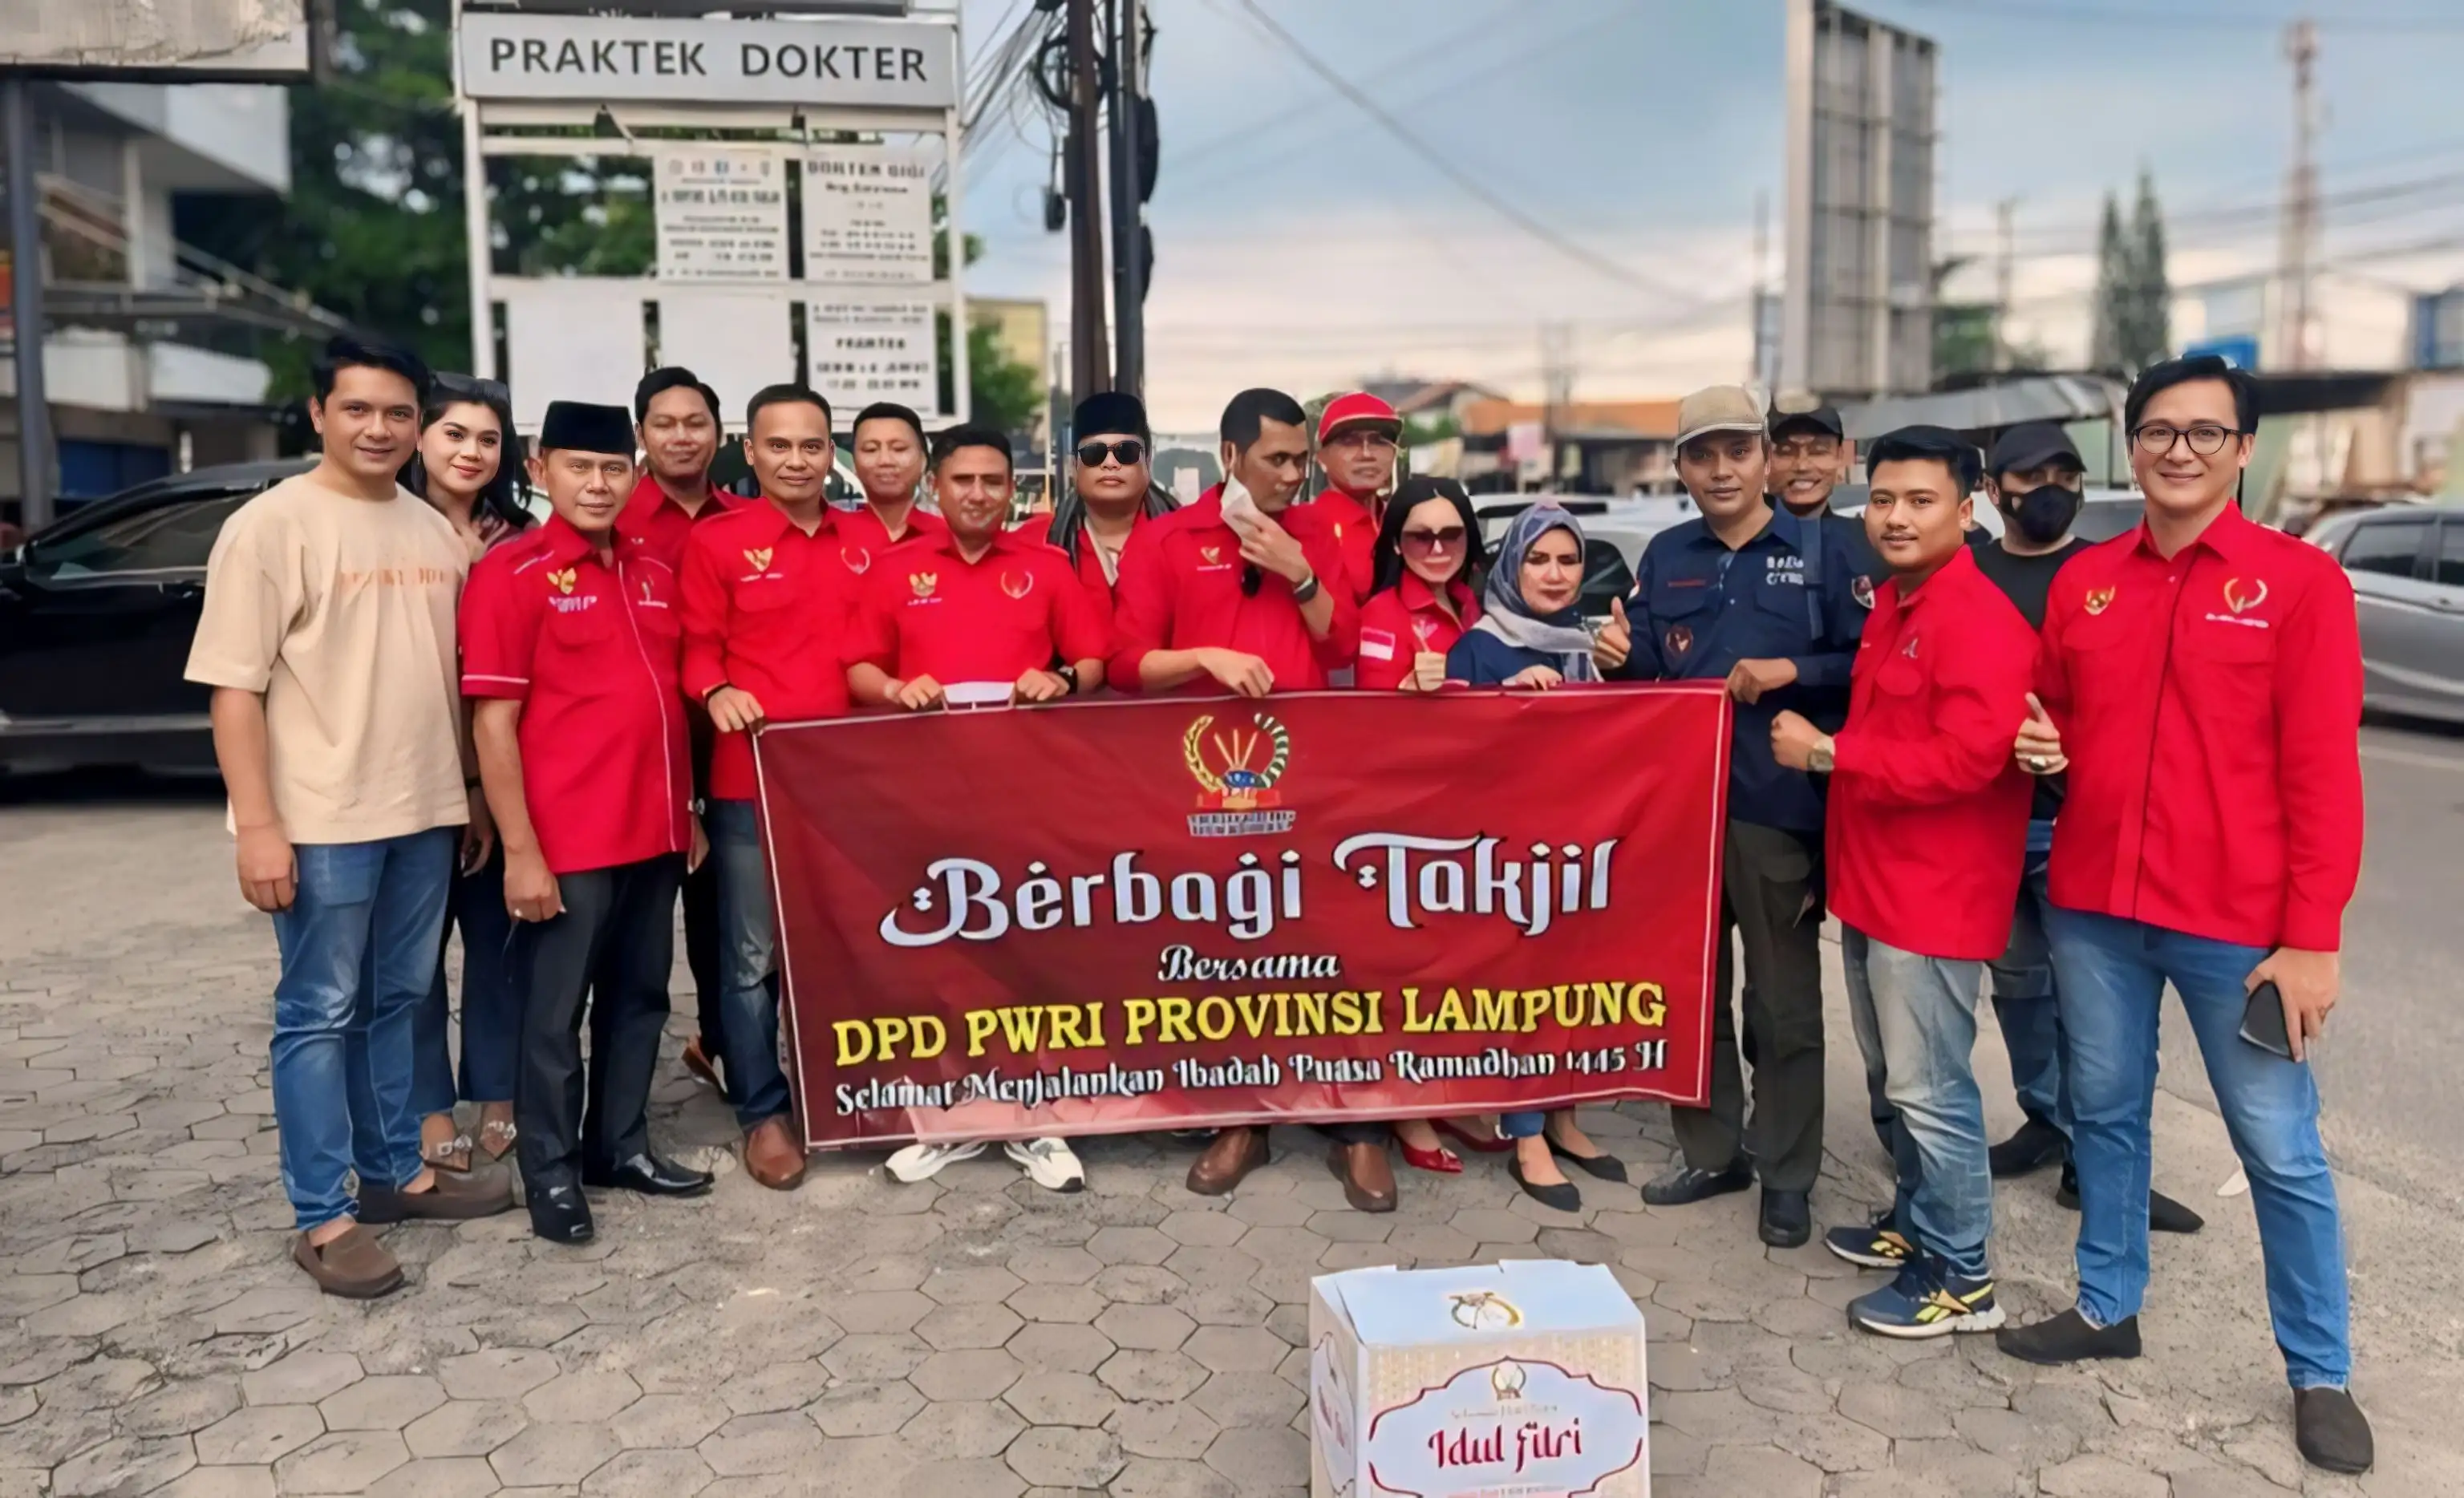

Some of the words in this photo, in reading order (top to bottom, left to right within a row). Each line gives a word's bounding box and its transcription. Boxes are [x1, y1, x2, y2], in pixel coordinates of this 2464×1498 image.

[490, 37, 707, 76] PRAKTEK
[740, 43, 928, 83] DOKTER
[878, 848, 1303, 948] Berbagi
[1331, 831, 1619, 937] Takjil
[1157, 944, 1339, 982] Bersama
[831, 1015, 947, 1067] DPD
[964, 1001, 1106, 1058] PWRI
[1122, 990, 1384, 1046] PROVINSI
[1401, 981, 1667, 1033] LAMPUNG
[835, 1074, 956, 1116] Selamat
[957, 1061, 1165, 1109] Menjalankan
[1171, 1053, 1281, 1088] Ibadah
[1287, 1052, 1381, 1084] Puasa
[1388, 1047, 1556, 1086] Ramadhan
[1566, 1047, 1627, 1075] 1445
[1633, 1038, 1668, 1071] H
[1428, 1424, 1506, 1469] Idul
